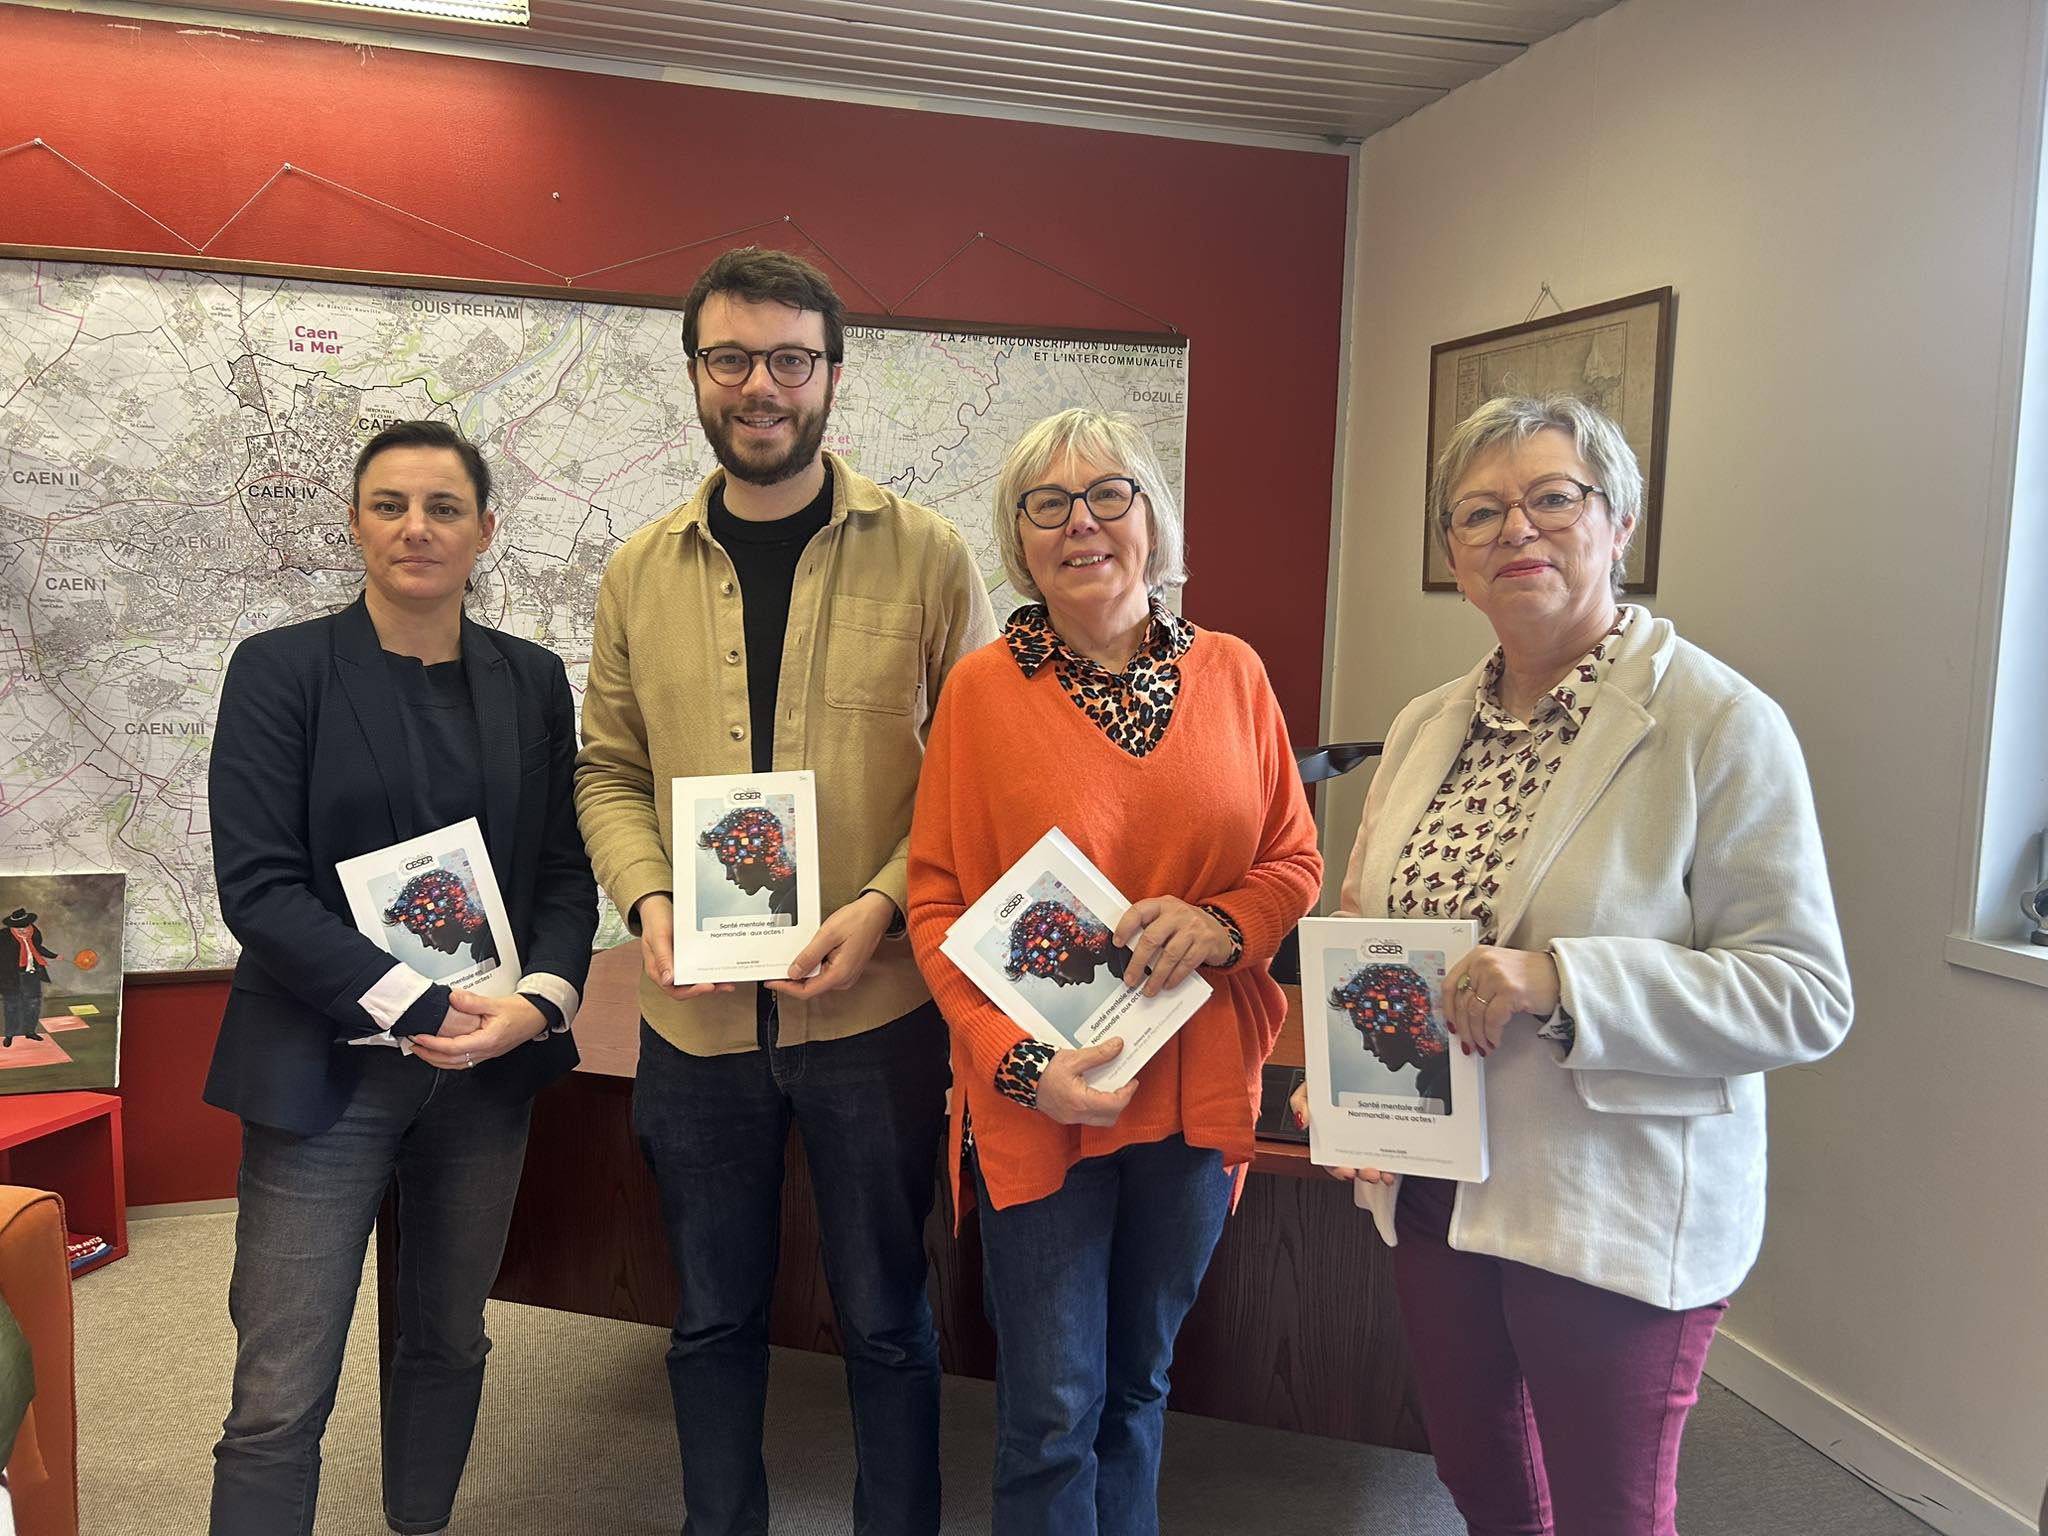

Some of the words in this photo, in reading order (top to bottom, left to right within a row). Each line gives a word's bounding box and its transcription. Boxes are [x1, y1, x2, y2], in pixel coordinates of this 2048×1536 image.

[411, 300, 520, 319] OUISTREHAM
[295, 326, 338, 340] Caen
[844, 327, 885, 340] OURG
[289, 340, 304, 352] la
[311, 341, 344, 354] Mer
[941, 332, 955, 342] LA
[987, 336, 1098, 350] CIRCONSCRIPTION
[1104, 343, 1119, 351] DU
[1124, 344, 1183, 355] CALVADOS
[1035, 352, 1048, 361] ET
[1053, 353, 1183, 368] L'INTERCOMMUNALITÉ
[1133, 391, 1183, 403] DOZULÉ
[359, 418, 392, 431] CAE
[838, 435, 850, 444] et
[13, 471, 64, 485] CAEN
[70, 473, 79, 486] II
[249, 485, 296, 499] CAEN
[302, 487, 317, 499] IV
[162, 536, 211, 549] CAEN
[218, 537, 231, 549] III
[45, 577, 96, 591] CAEN
[102, 578, 107, 591] I
[125, 723, 174, 735] CAEN
[179, 723, 205, 735] VIII
[734, 791, 762, 801] CESER
[406, 855, 434, 871] CESER
[1000, 893, 1025, 919] CESER
[1369, 944, 1403, 955] CESER
[1130, 990, 1144, 1003] acte
[1348, 1110, 1390, 1120] Normandie
